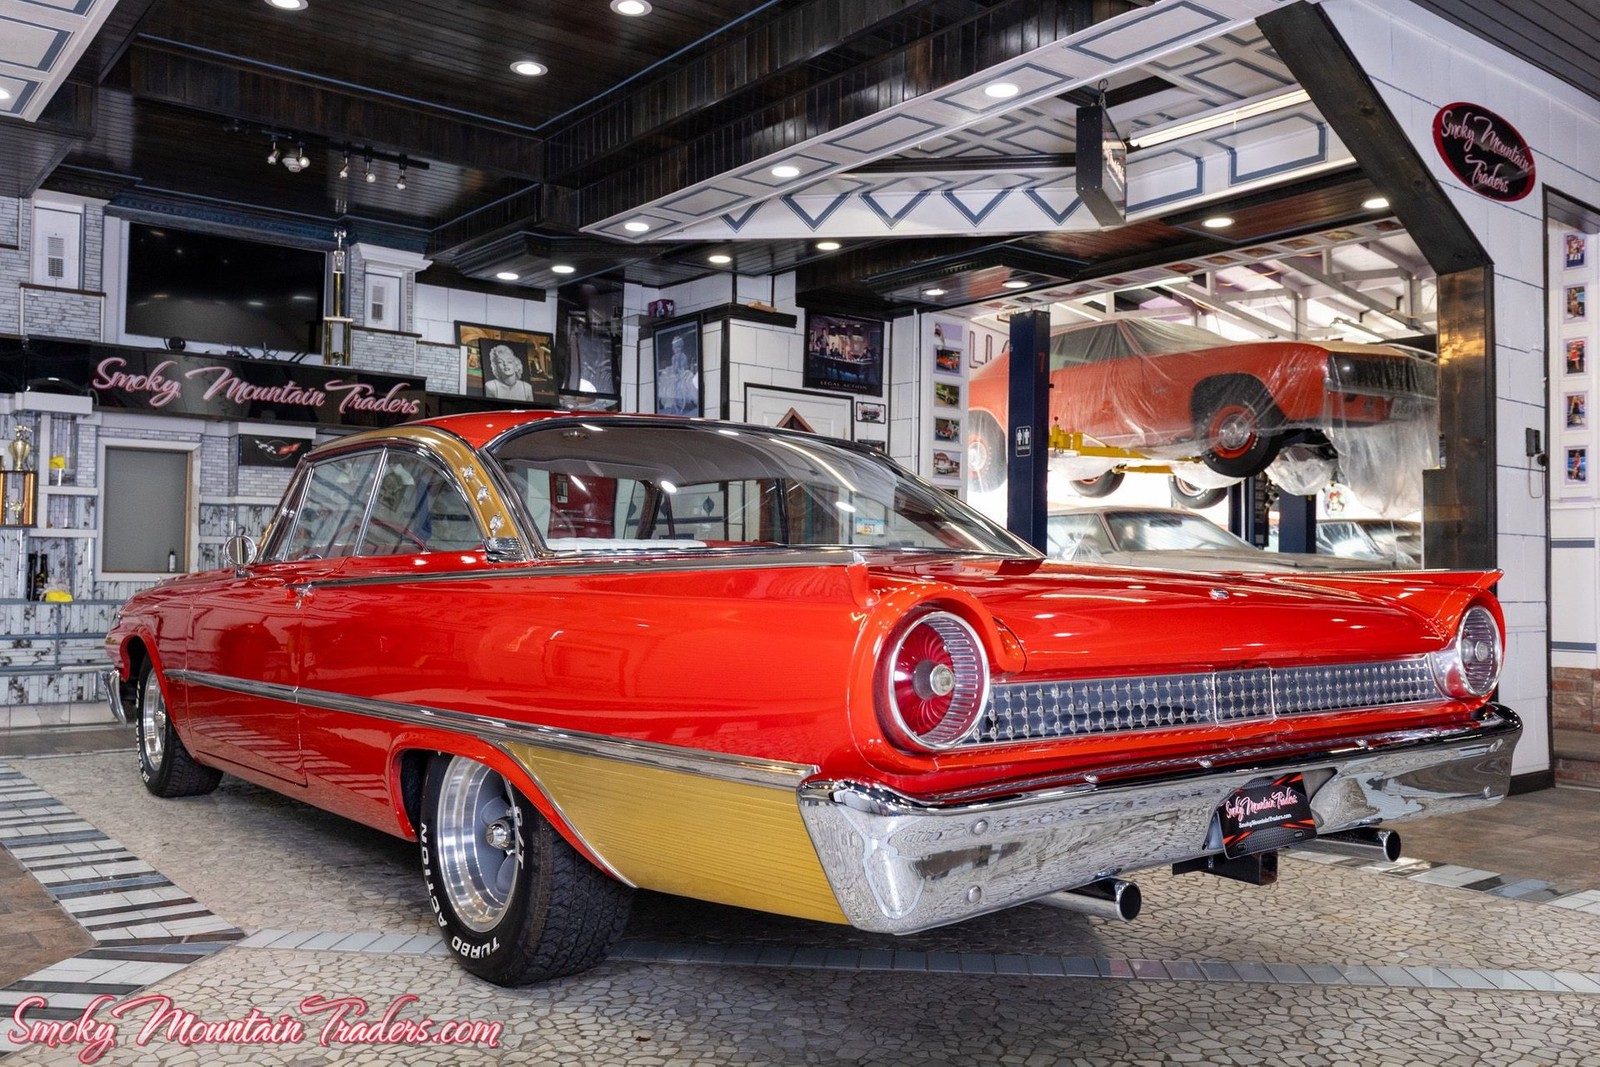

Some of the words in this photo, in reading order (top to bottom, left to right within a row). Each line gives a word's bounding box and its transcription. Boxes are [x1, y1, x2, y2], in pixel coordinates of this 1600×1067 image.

[1441, 109, 1475, 152] Smoky
[1473, 116, 1530, 172] Mountain
[1464, 154, 1510, 193] Traders
[92, 356, 182, 408] Smoky
[185, 365, 326, 407] Mountain
[325, 377, 421, 415] Traders
[1225, 795, 1245, 822] Smoky
[1240, 796, 1276, 816] Mountain
[1271, 787, 1298, 810] Traders
[420, 822, 448, 928] ACTION
[451, 935, 501, 959] TURBO
